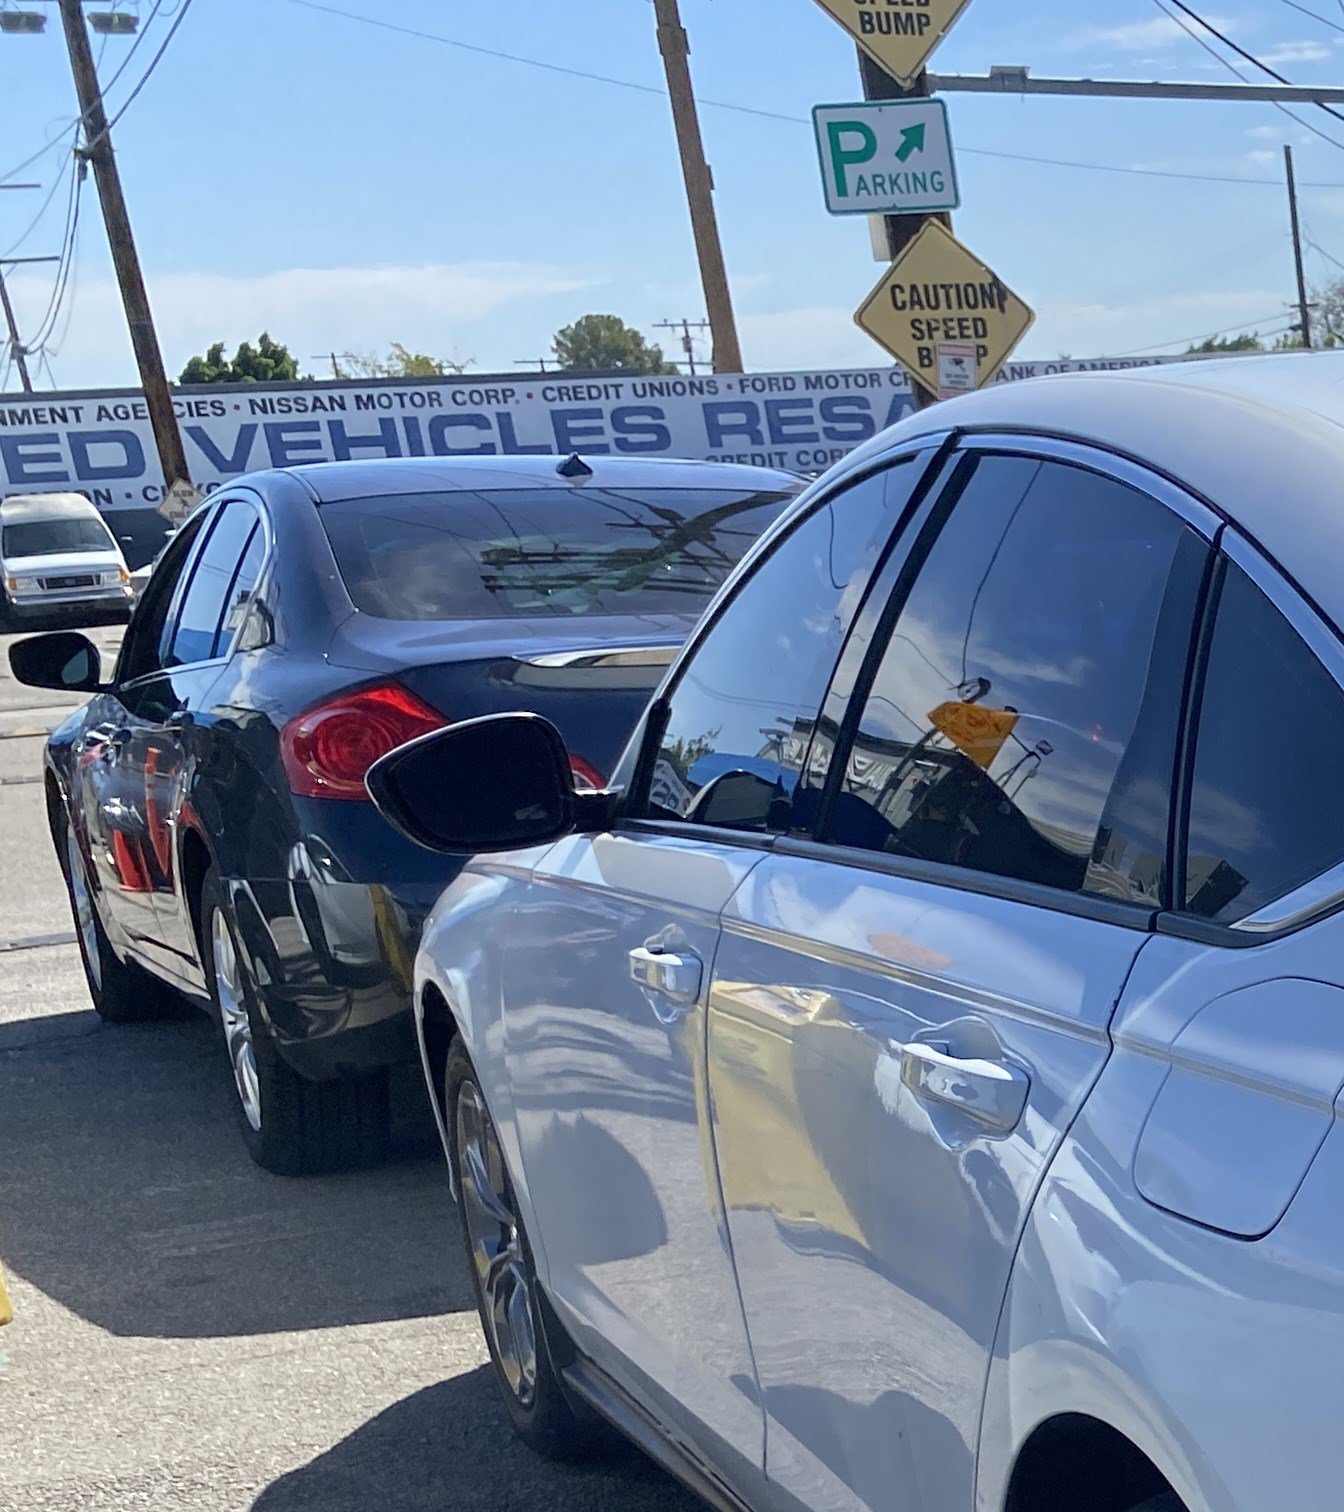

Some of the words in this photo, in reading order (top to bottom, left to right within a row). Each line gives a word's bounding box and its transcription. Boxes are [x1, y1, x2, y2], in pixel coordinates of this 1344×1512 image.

[858, 11, 931, 36] BUMP
[911, 318, 988, 341] SPEED
[917, 344, 989, 369] BP
[96, 400, 226, 422] AGECIES
[248, 396, 347, 416] NISSAN
[355, 389, 443, 411] MOTOR
[541, 383, 624, 403] CREDIT
[632, 379, 720, 398] UNIONS
[739, 375, 797, 394] FORD
[804, 371, 883, 391] MOTOR
[995, 365, 1037, 382] ANK
[185, 405, 672, 473] VEHICLES
